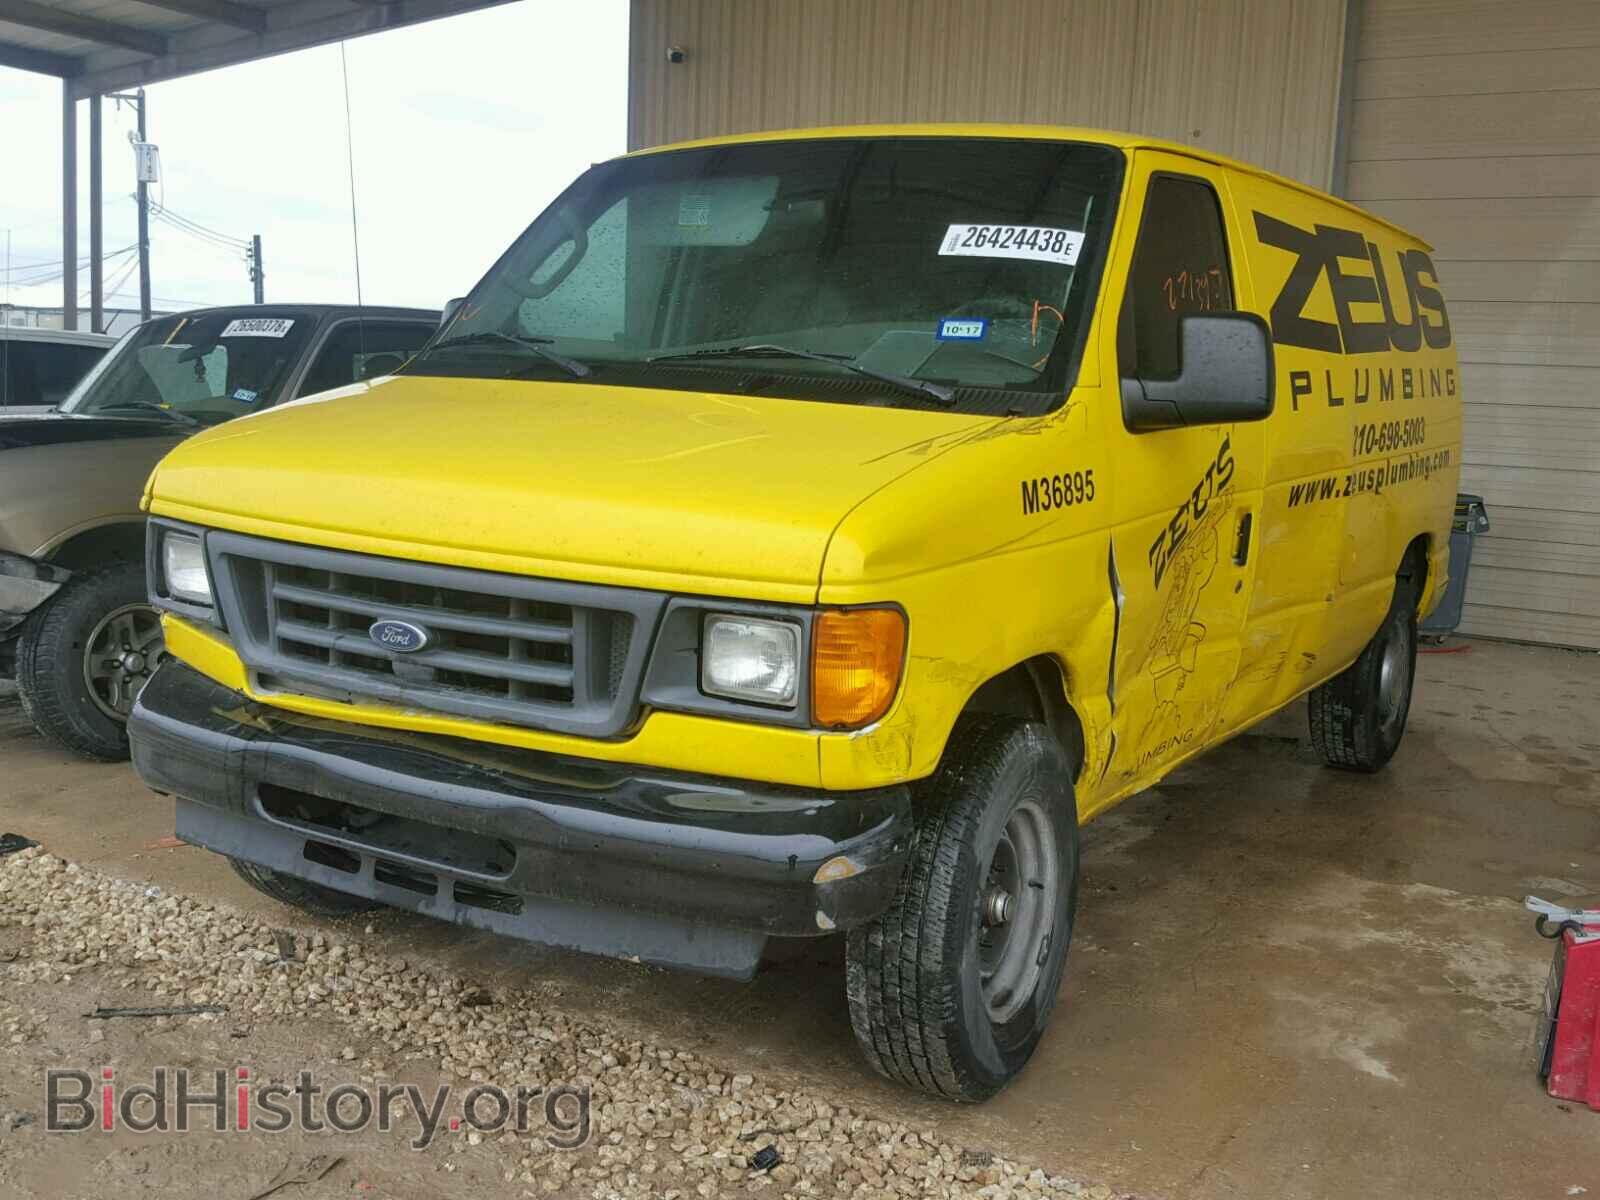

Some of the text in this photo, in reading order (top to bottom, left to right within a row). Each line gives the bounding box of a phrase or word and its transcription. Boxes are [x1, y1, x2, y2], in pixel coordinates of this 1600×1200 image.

[1252, 210, 1451, 355] ZEUS
[1289, 367, 1456, 411] PLUMBING
[1021, 468, 1095, 516] M36895
[1287, 448, 1450, 508] www.zeusplumbing.com
[1148, 431, 1235, 591] ZEUS
[381, 625, 410, 646] Ford
